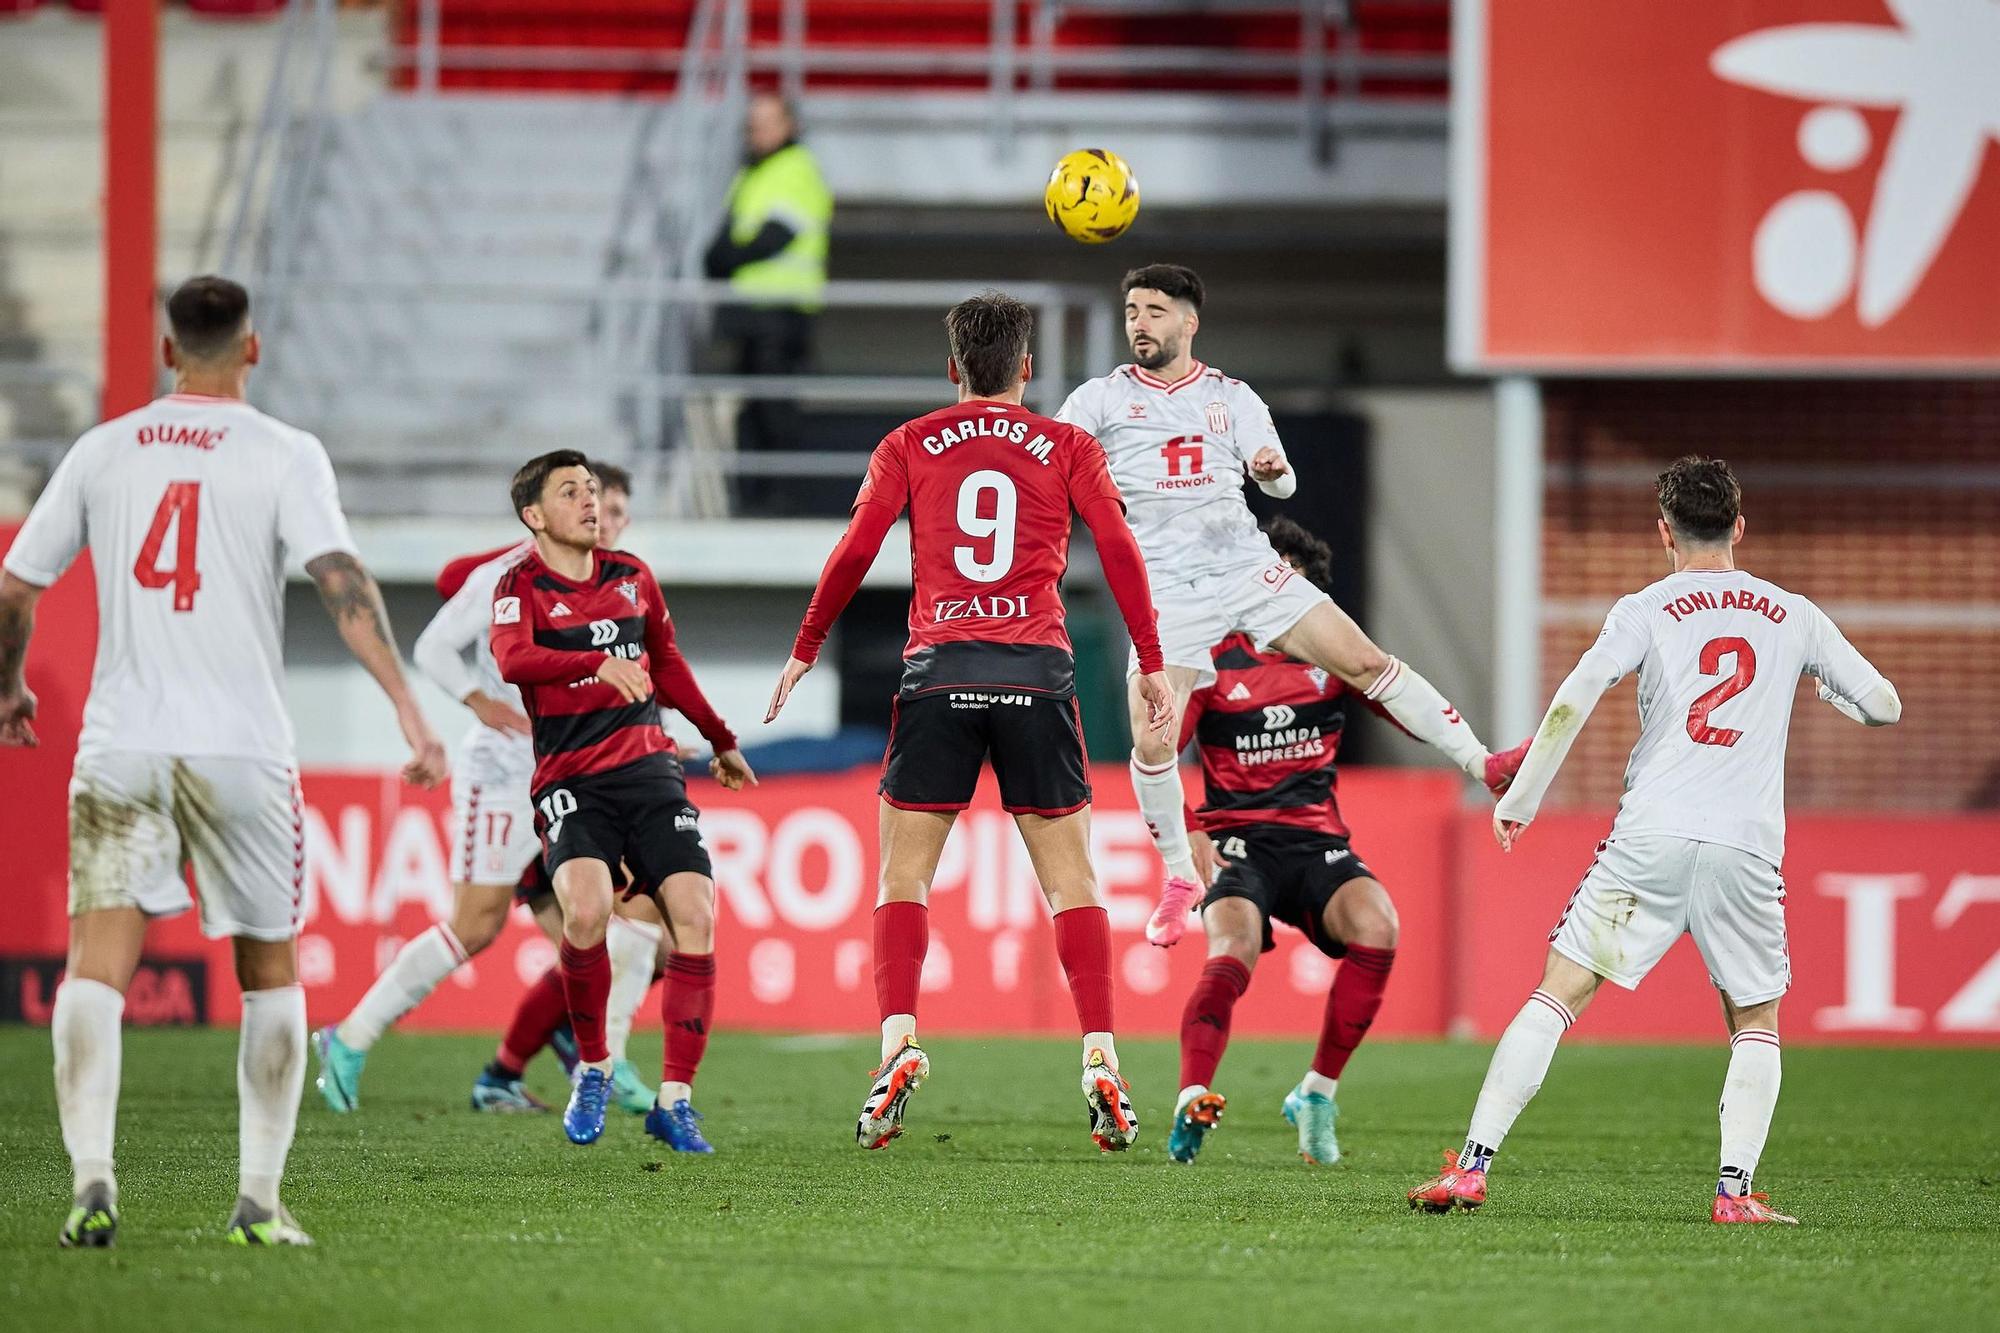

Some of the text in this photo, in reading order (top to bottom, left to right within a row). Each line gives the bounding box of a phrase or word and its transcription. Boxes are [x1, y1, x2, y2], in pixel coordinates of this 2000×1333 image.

[922, 418, 1054, 465] CARLOS M.
[1161, 435, 1203, 476] fi
[1156, 474, 1215, 489] network
[954, 470, 1016, 582] 9
[134, 481, 201, 611] 4
[934, 595, 1029, 623] IZADI
[1663, 590, 1787, 624] TONI ABAD
[1686, 637, 1756, 747] 2
[1236, 726, 1321, 750] MIRANDA
[1237, 739, 1325, 766] EMPRESAS
[539, 788, 578, 823] 10
[486, 811, 514, 846] 17
